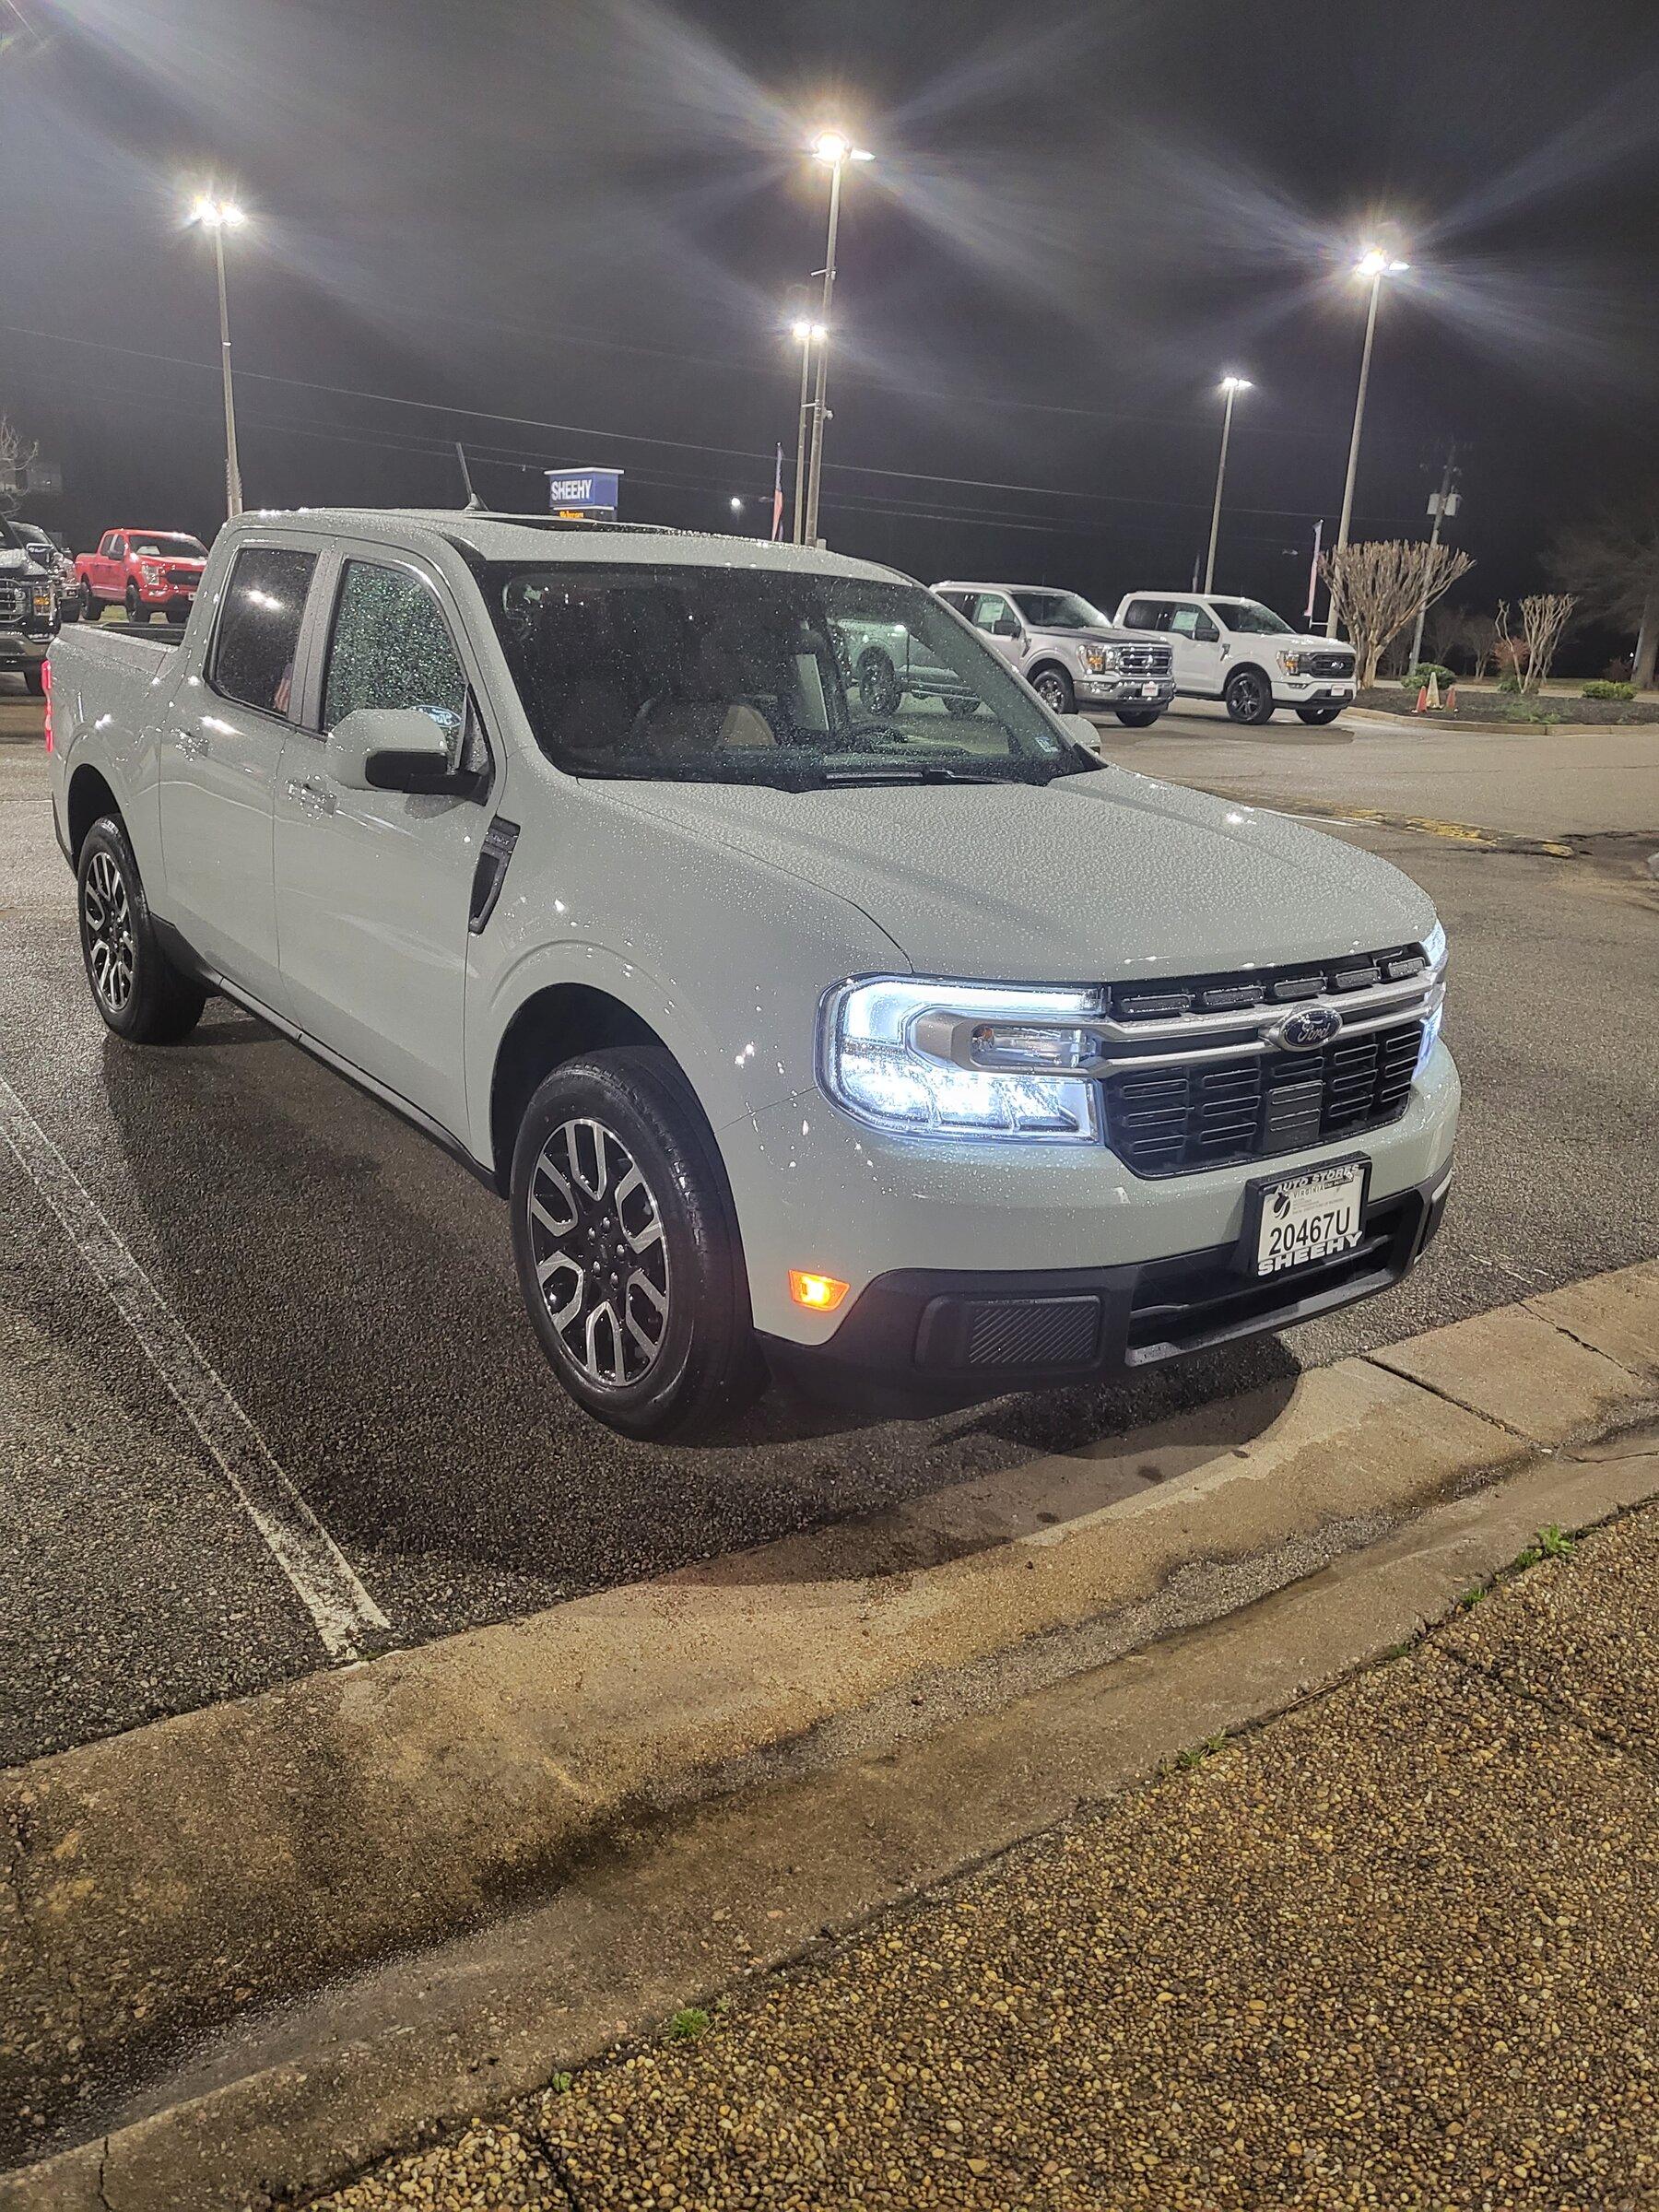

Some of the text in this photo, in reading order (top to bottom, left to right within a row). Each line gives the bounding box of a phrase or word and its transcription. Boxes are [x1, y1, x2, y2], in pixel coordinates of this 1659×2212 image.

[551, 479, 593, 500] SHEEHY
[1298, 1018, 1331, 1042] Ford
[1274, 1177, 1309, 1195] AUTO
[1311, 1164, 1359, 1182] STORES
[1293, 1185, 1324, 1198] VIRGINIA
[1268, 1206, 1350, 1256] 20467U
[1257, 1230, 1363, 1276] SHEEHY
